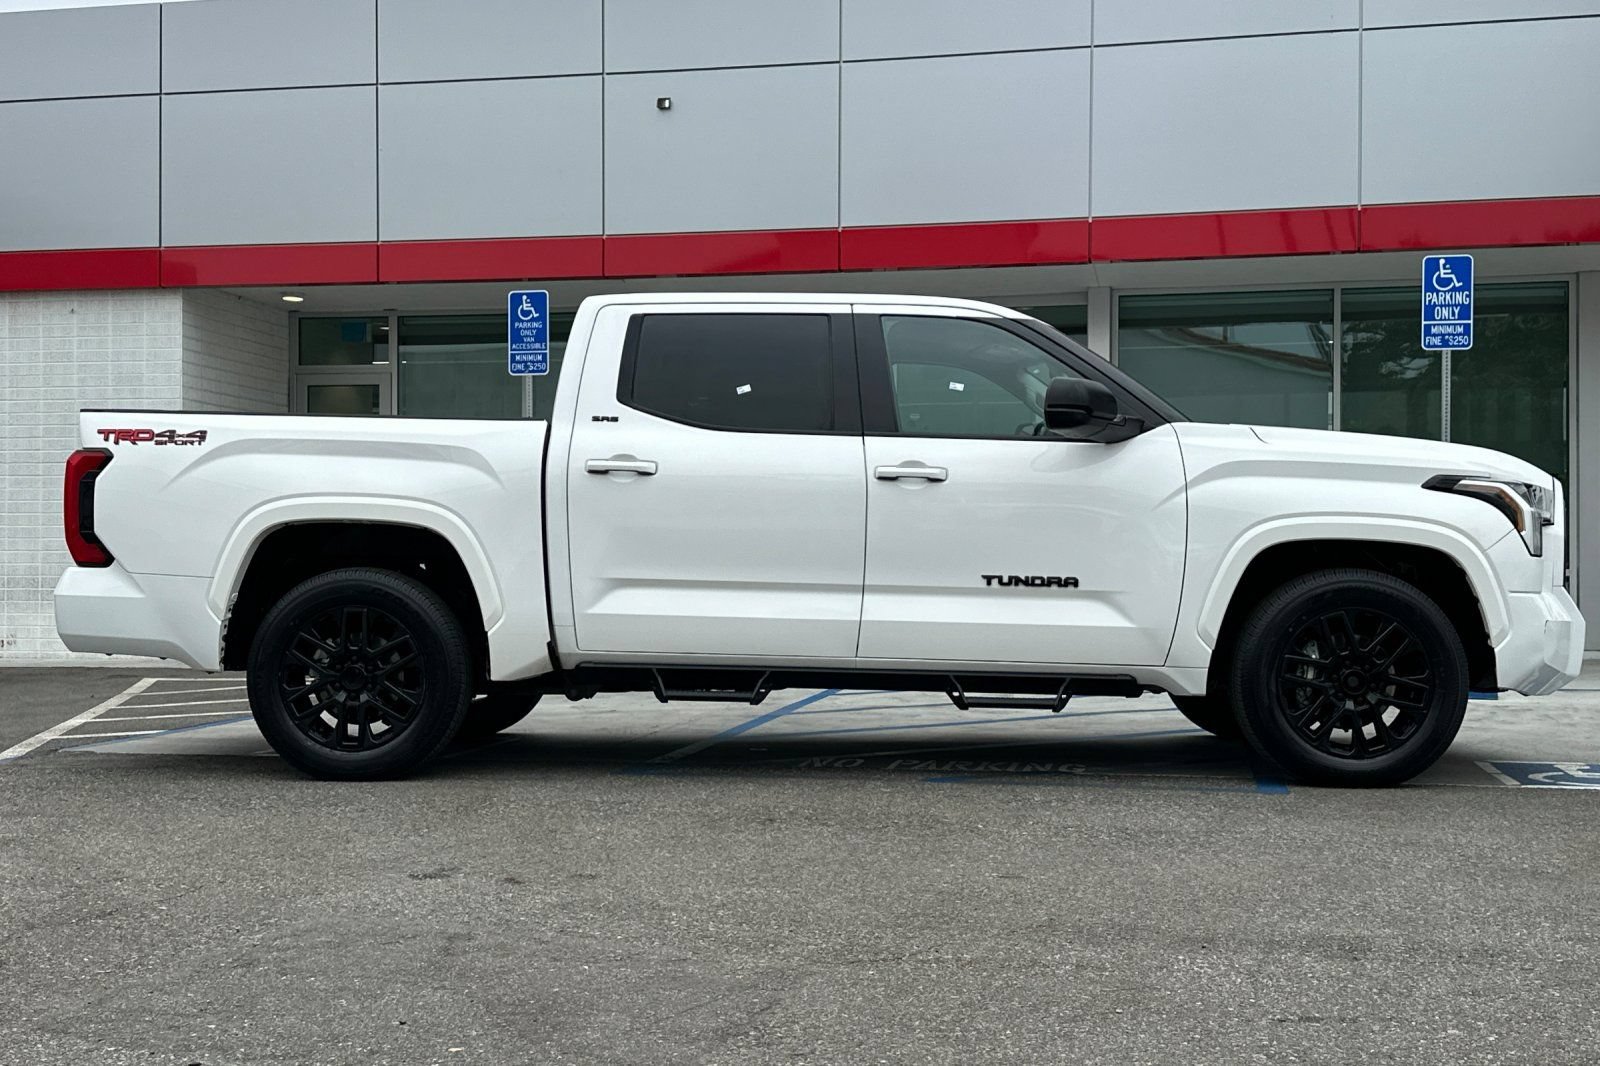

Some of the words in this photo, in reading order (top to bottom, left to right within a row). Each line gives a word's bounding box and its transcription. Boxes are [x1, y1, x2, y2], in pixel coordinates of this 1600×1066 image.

[1425, 291, 1470, 305] PARKING
[1434, 305, 1461, 320] ONLY
[514, 321, 543, 329] PARKING
[1431, 324, 1464, 335] MINIMUM
[520, 329, 537, 337] ONLY
[511, 342, 546, 350] ACCESSIBLE
[1425, 336, 1443, 346] FINE
[515, 353, 543, 362] MINIMUM
[511, 363, 525, 371] FINE
[97, 428, 155, 446] TRD
[980, 574, 1080, 589] TUNDRA
[799, 756, 865, 769] NO
[887, 759, 1088, 775] PARKING
